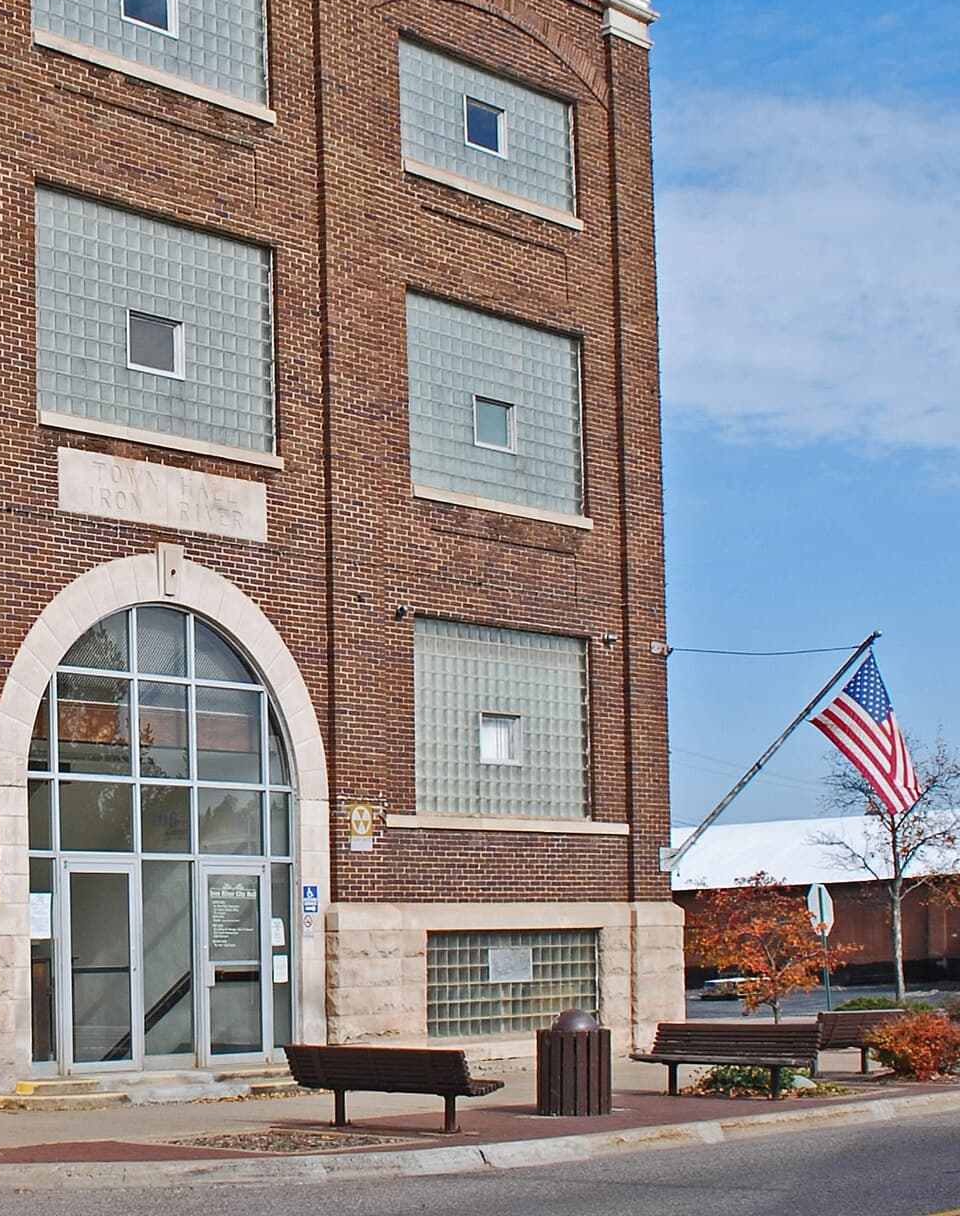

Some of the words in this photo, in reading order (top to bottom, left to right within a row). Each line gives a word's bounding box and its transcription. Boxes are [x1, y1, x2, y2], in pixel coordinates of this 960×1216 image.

[92, 460, 160, 490] TOWN
[180, 475, 238, 505] HALL
[89, 486, 144, 514] IRON
[180, 501, 243, 529] RIVER
